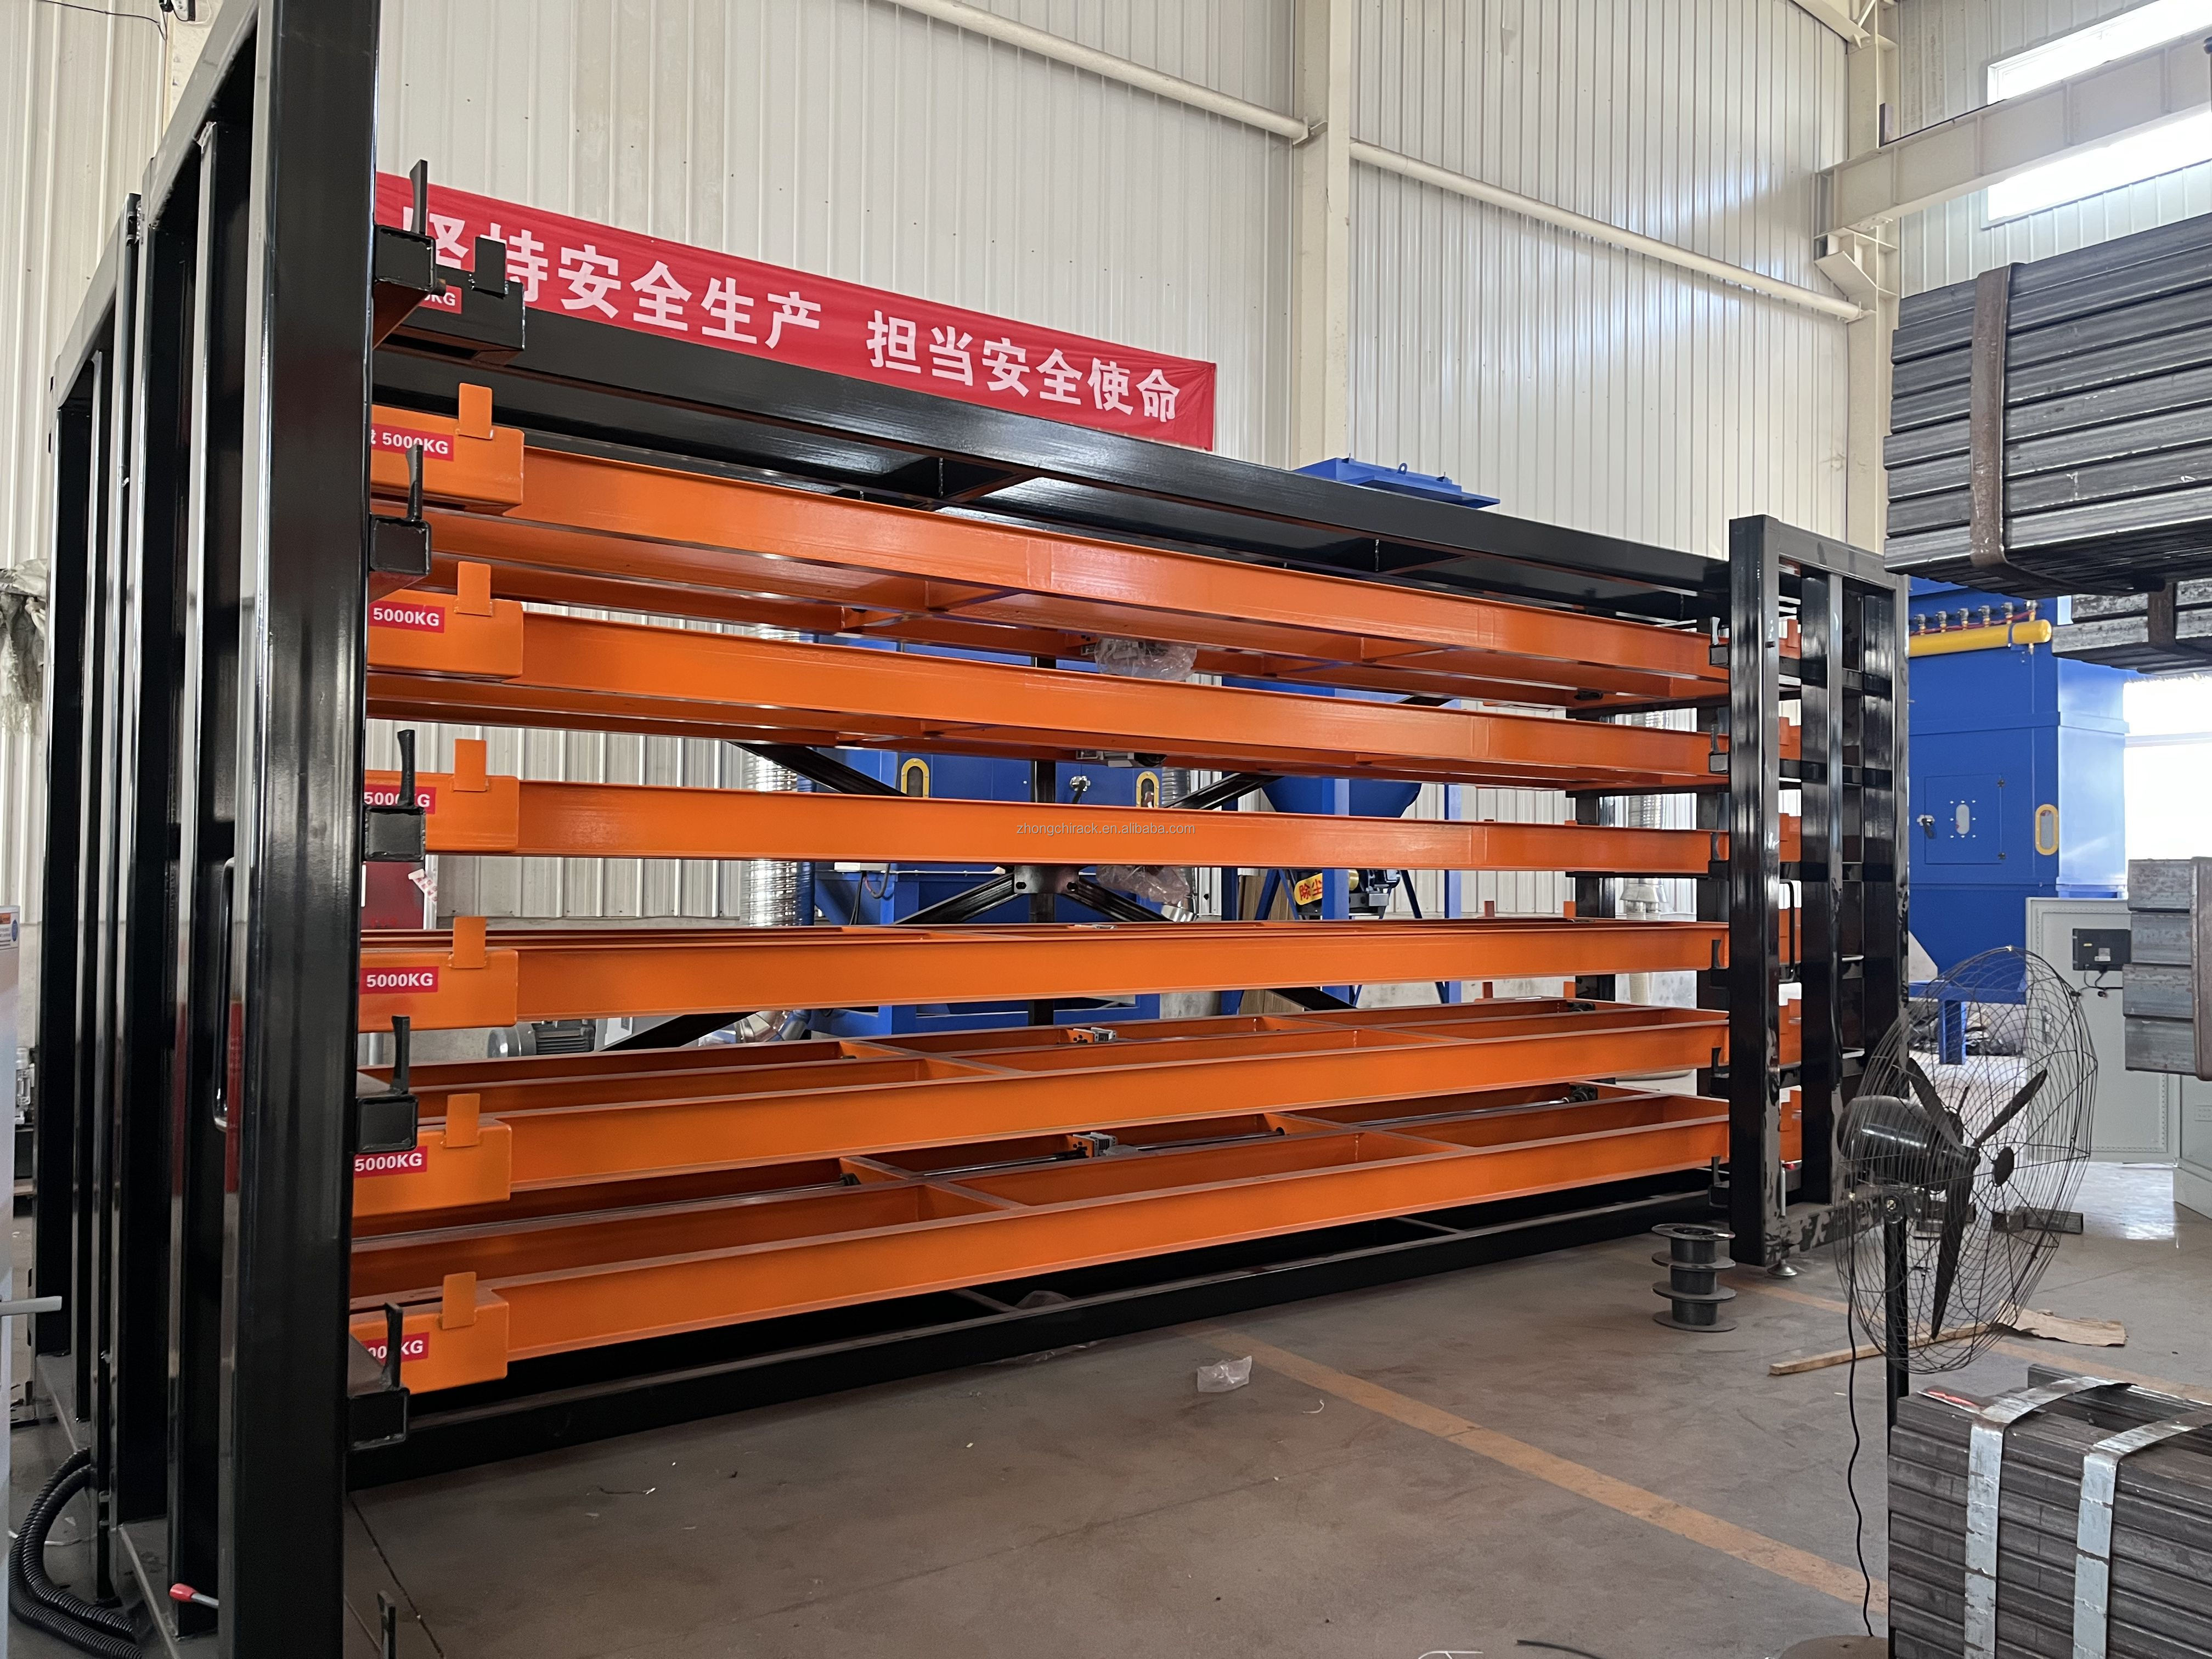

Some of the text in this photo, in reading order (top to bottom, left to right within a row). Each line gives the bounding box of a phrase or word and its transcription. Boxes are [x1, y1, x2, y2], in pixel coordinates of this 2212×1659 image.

[866, 309, 1181, 422] 担当安全使命
[373, 607, 439, 627] 5000KG
[364, 792, 430, 808] 500G
[1299, 879, 1322, 901] 除尘
[366, 973, 433, 988] 5000KG
[355, 1153, 422, 1172] 5000KG
